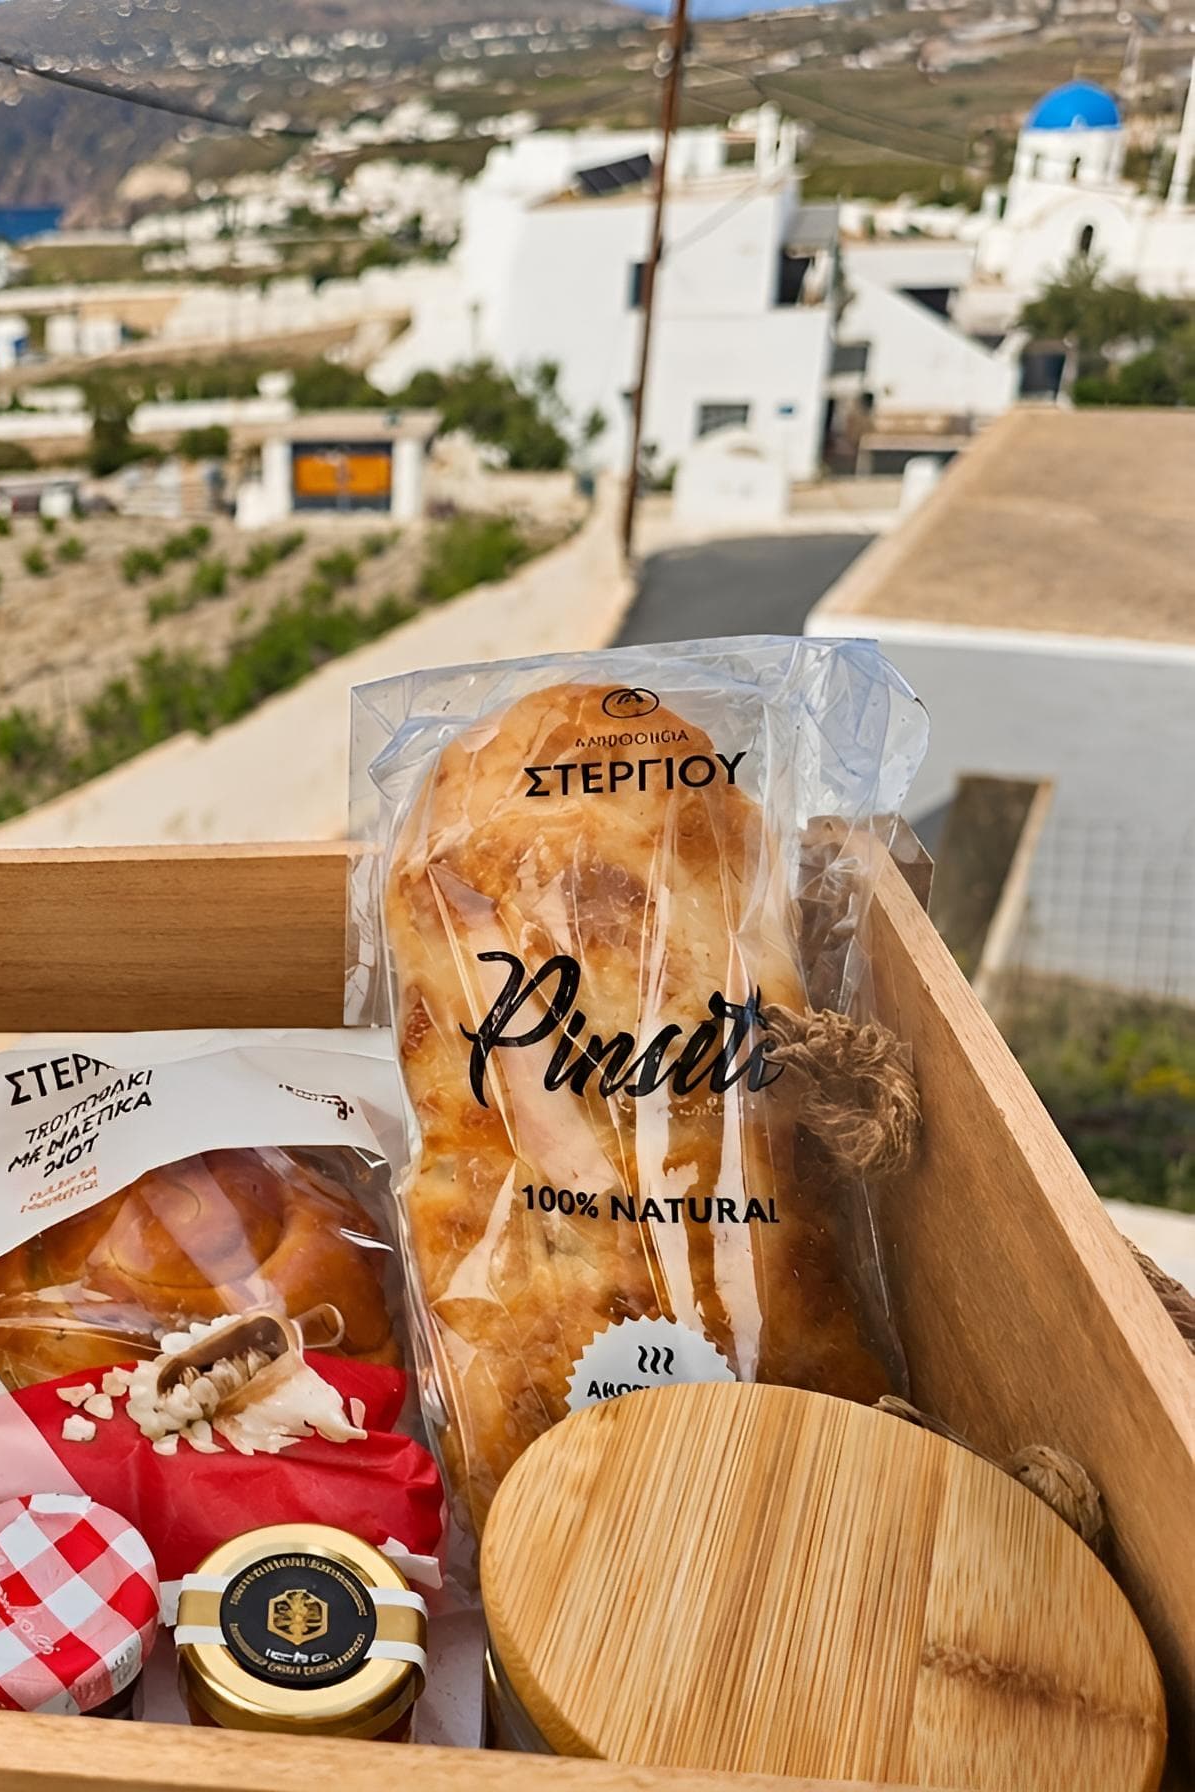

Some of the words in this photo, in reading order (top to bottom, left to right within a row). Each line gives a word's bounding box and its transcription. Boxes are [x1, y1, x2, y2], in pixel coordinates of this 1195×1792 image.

[524, 751, 747, 797] ΣΤΕΡΓΙΟΥ
[521, 1184, 598, 1218] 100%
[610, 1194, 781, 1224] NATURAL
